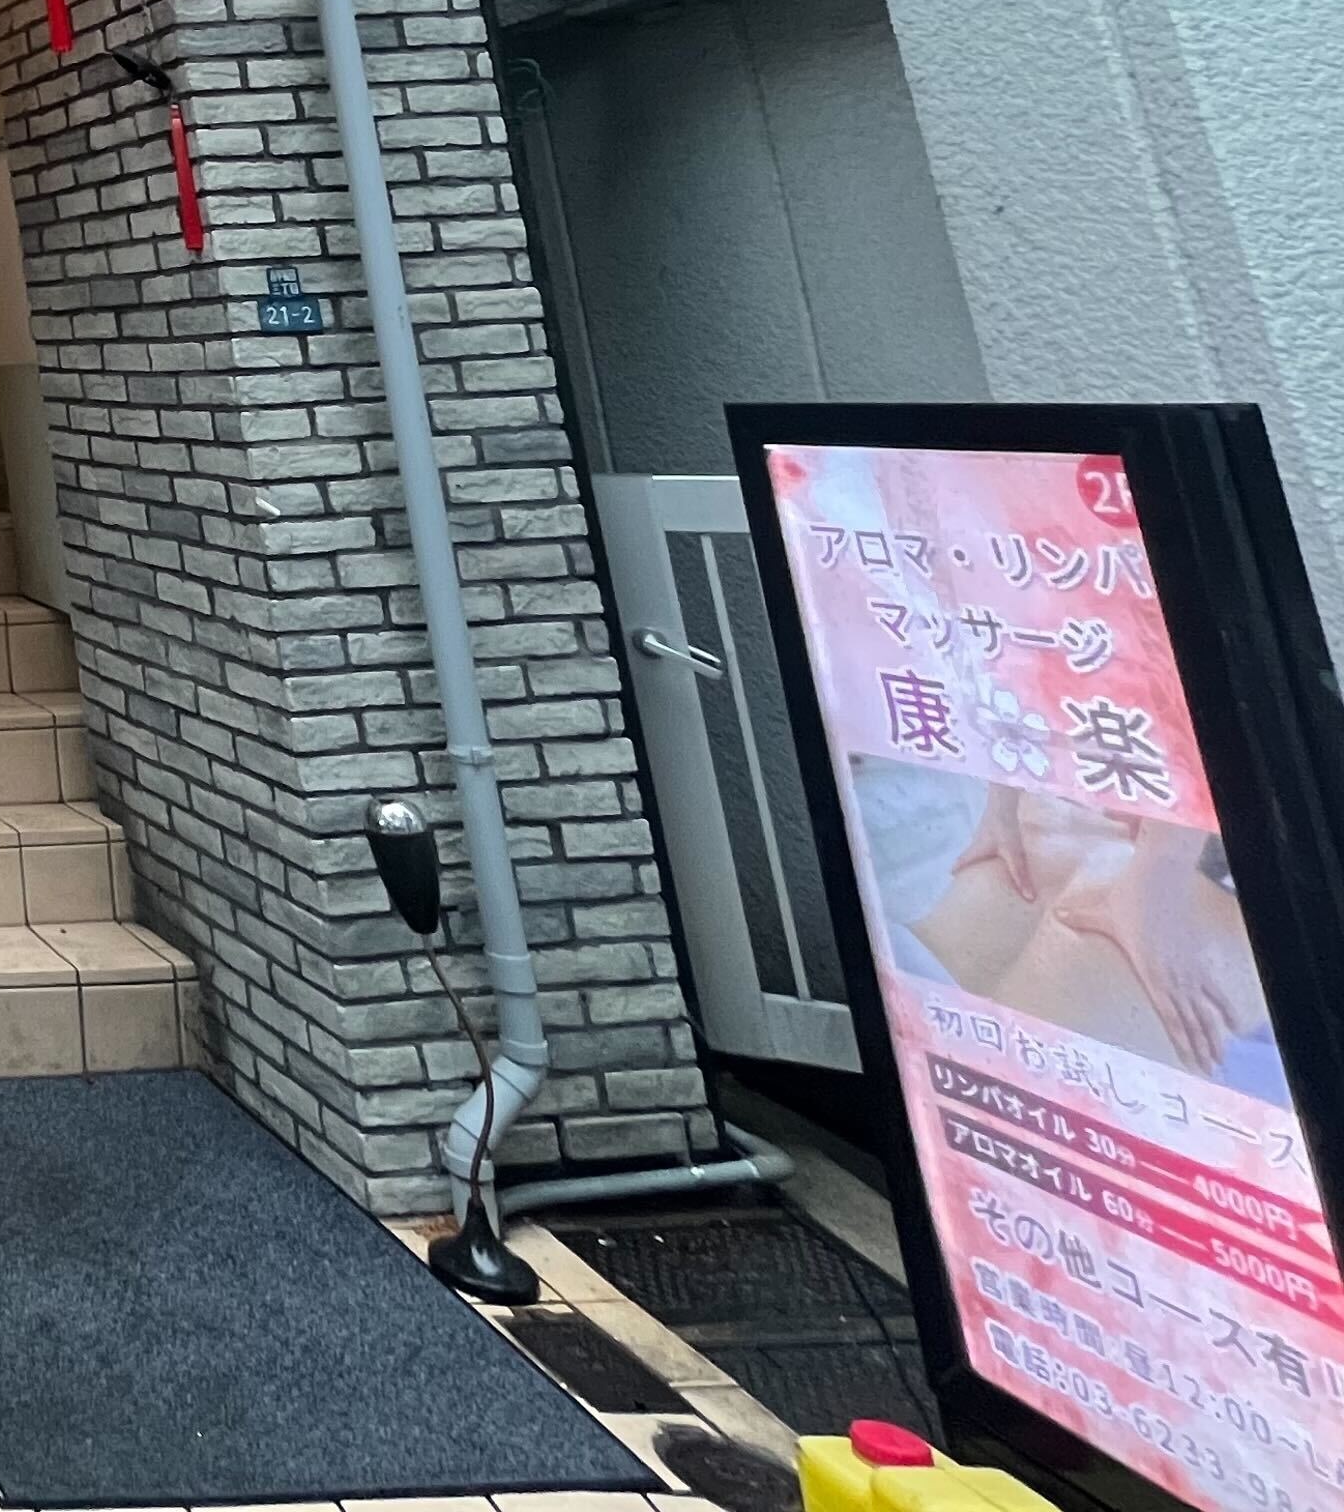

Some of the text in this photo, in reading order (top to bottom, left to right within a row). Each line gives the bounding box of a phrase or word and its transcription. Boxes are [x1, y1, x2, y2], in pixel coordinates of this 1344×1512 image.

[266, 305, 316, 326] 21-2
[809, 522, 1153, 598] アロマ・リンパ
[868, 600, 1112, 678] マッサージ
[880, 670, 1172, 802] 康 楽
[934, 1061, 1077, 1140] リンパオイル
[1083, 1126, 1137, 1169] 30分
[947, 1117, 1318, 1312] アロマオイル 60分 5000円
